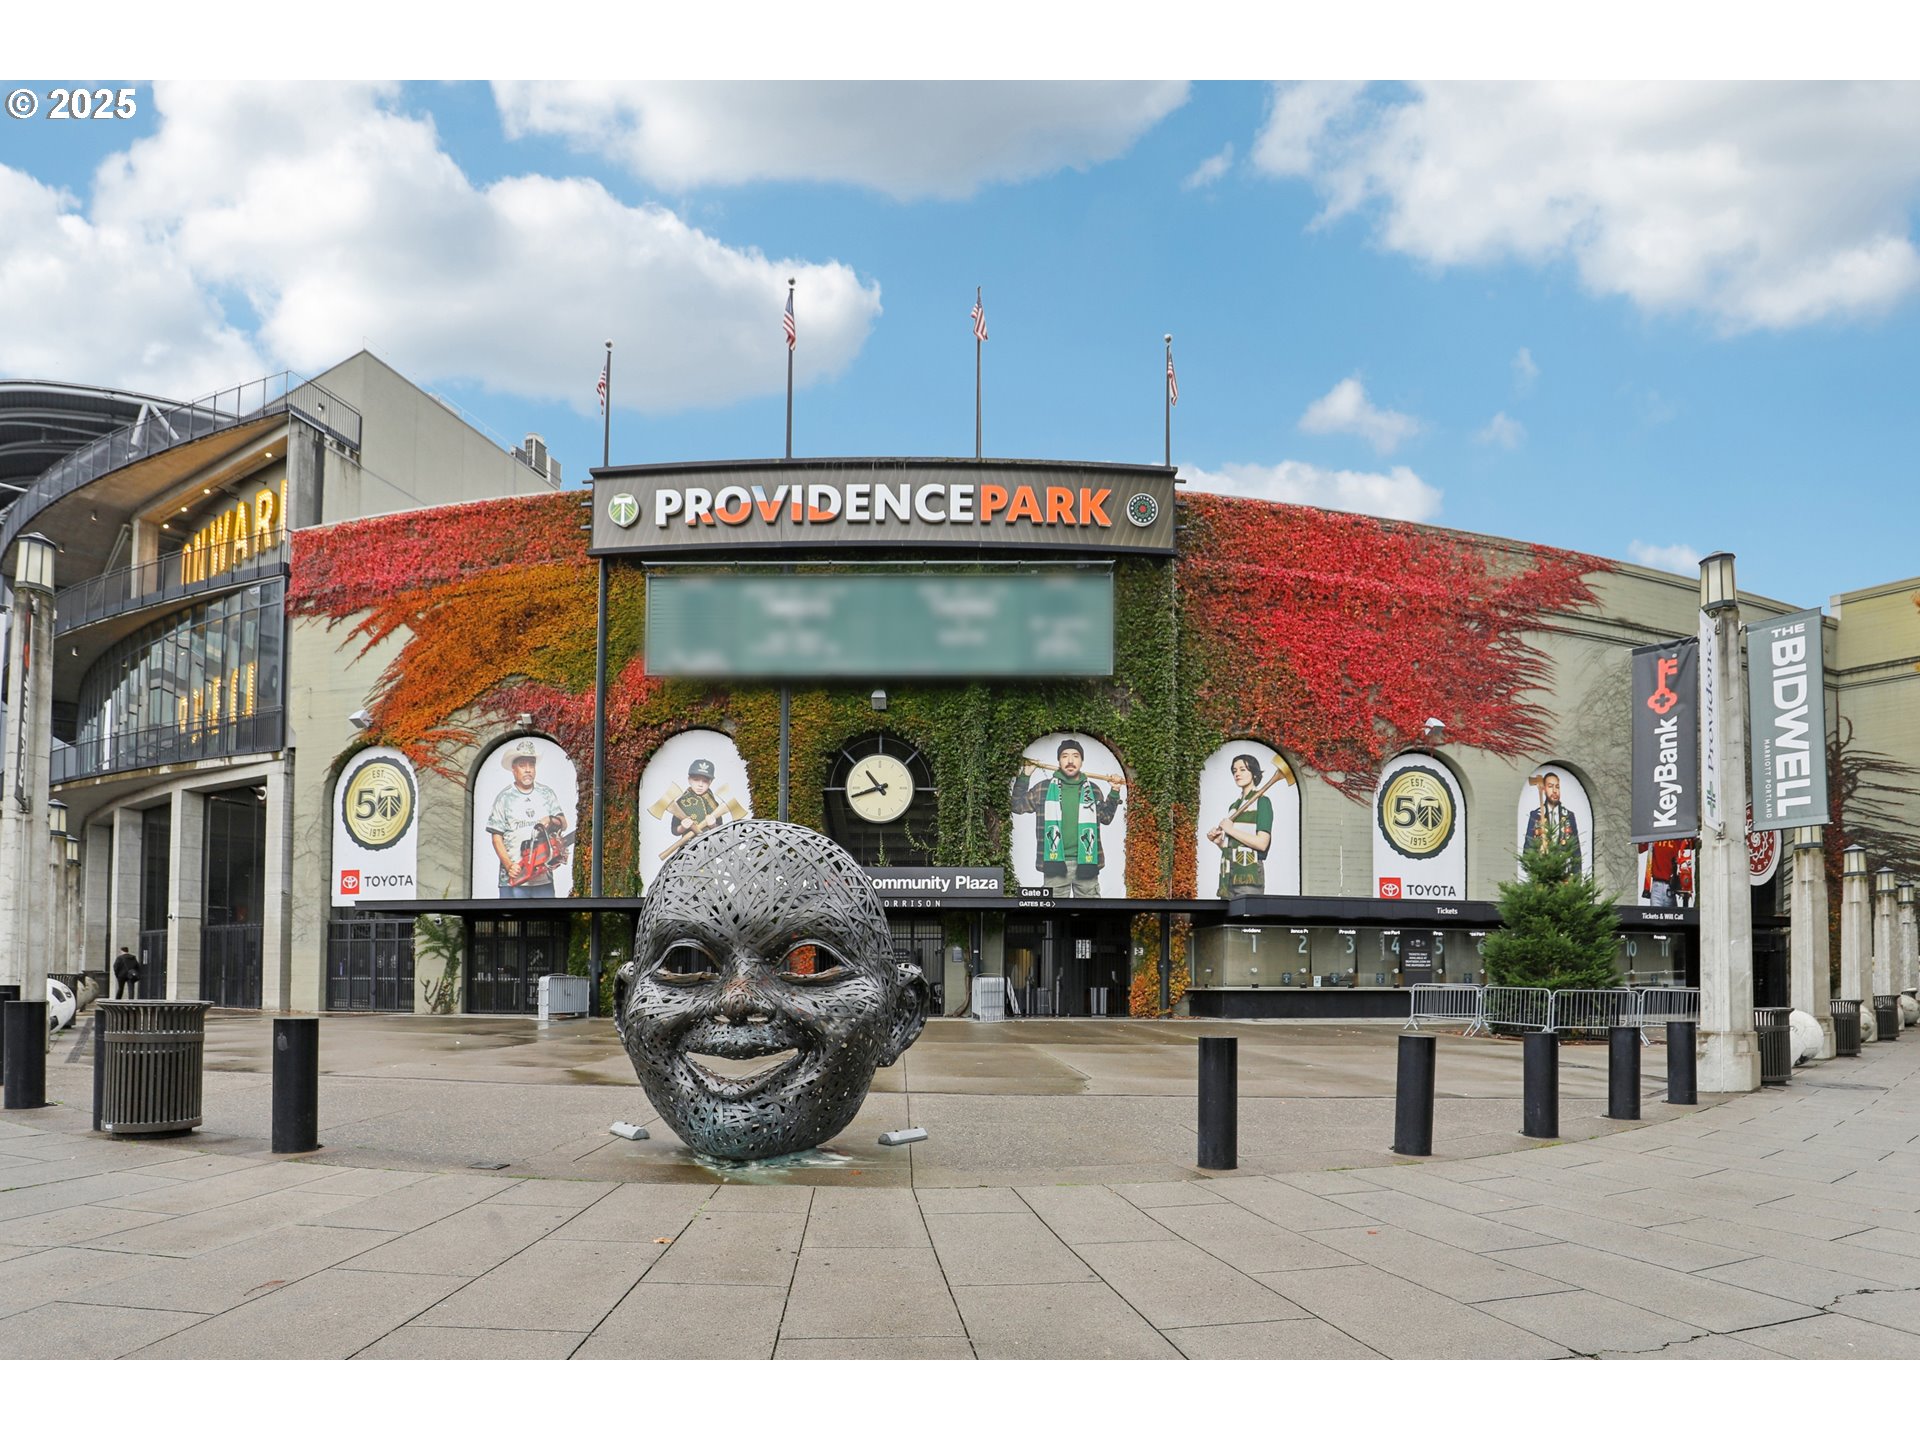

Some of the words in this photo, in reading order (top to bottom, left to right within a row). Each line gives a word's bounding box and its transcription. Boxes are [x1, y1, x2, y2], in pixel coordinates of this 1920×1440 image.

[181, 480, 288, 585] ONWAR
[1771, 623, 1806, 638] THE
[1705, 628, 1716, 772] Providence
[1771, 636, 1812, 817] BIDWELL
[1764, 738, 1772, 776] MARRIOTT
[371, 770, 386, 779] EST.
[1653, 715, 1683, 828] KeyBank
[1410, 778, 1425, 788] EST.
[1765, 779, 1773, 818] PORTLAND
[369, 827, 386, 837] 1975
[1410, 837, 1427, 847] 1975
[364, 875, 413, 887] TOYOTA
[866, 876, 951, 892] ommunity
[955, 876, 998, 890] Plaza
[1021, 888, 1041, 896] Gate
[1406, 884, 1457, 897] TOYOTA
[1436, 907, 1458, 915] Tickets
[1251, 934, 1256, 953] 1
[1298, 935, 1308, 953] 2
[1346, 936, 1354, 953] 3
[1391, 937, 1400, 954] 4
[1435, 937, 1443, 954] 5
[1626, 941, 1637, 957] 10
